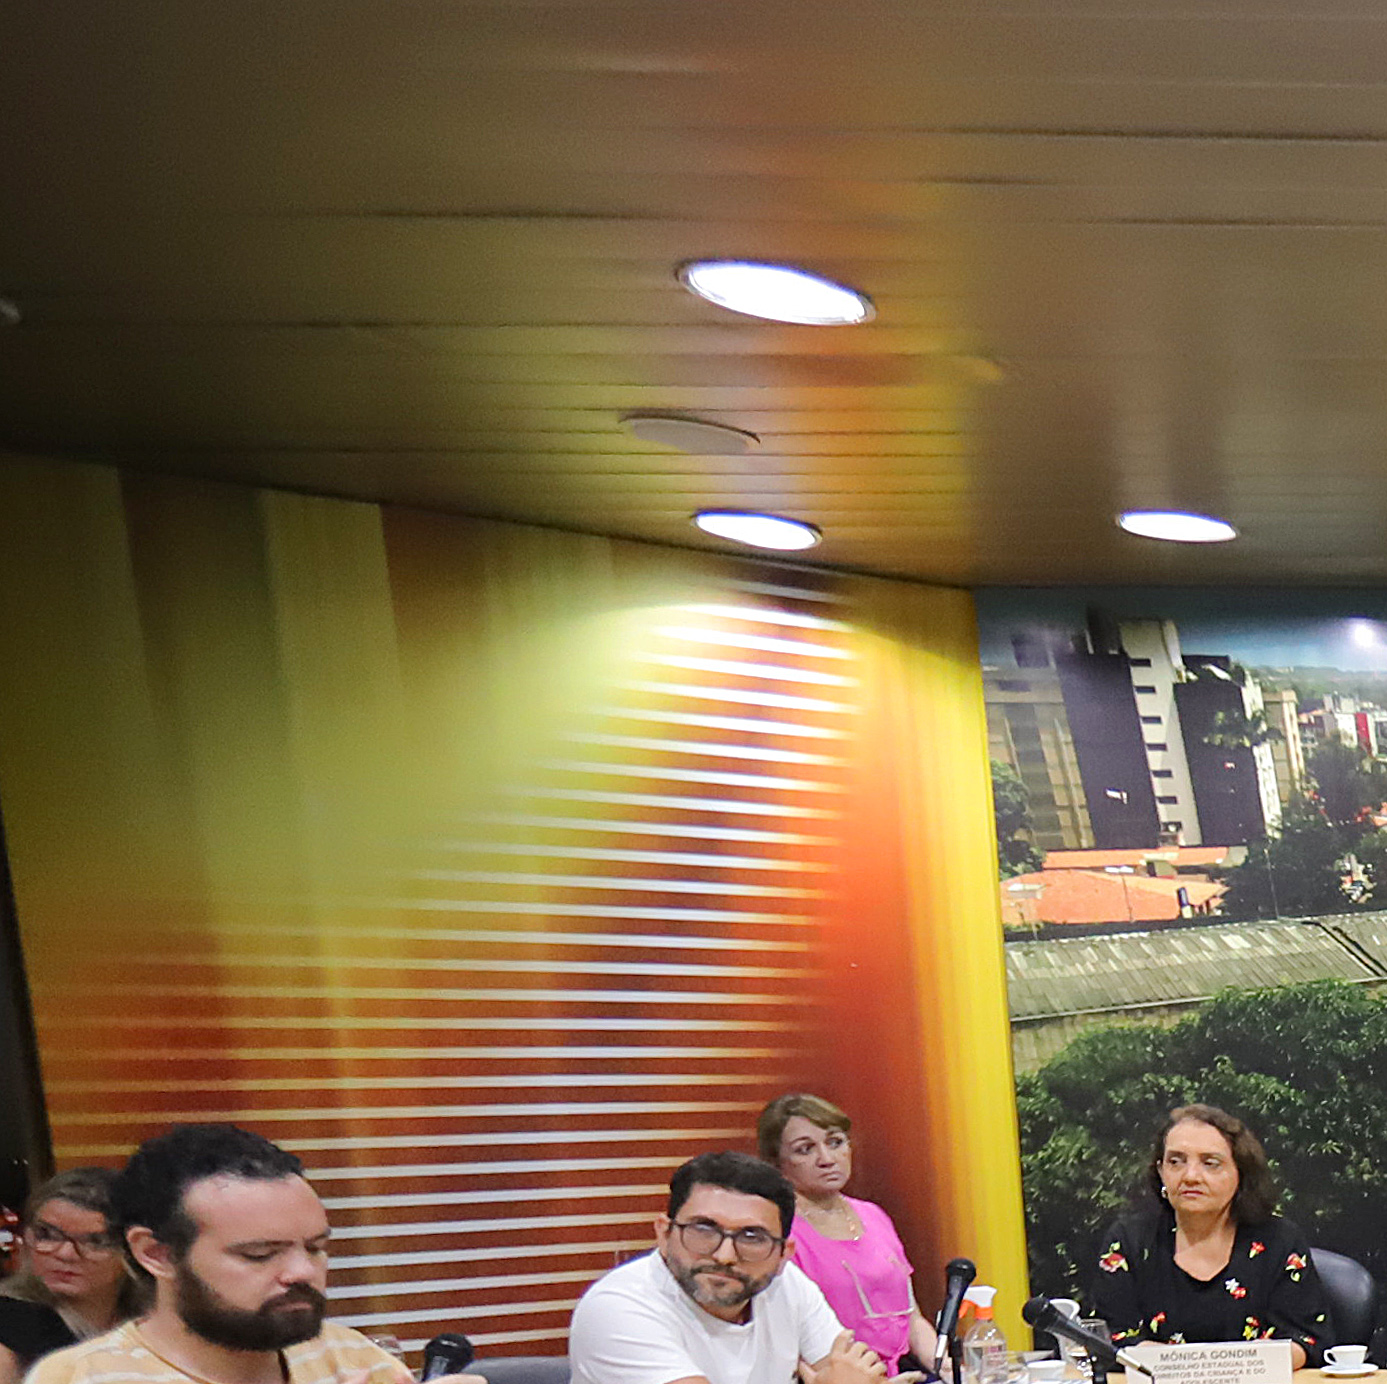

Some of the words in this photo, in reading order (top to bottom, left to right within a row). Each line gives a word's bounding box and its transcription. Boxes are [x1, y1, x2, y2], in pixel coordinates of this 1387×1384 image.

[1160, 1350, 1207, 1362] MÔNICA
[1211, 1348, 1257, 1359] GONDIM
[1153, 1362, 1200, 1372] CONSELHO
[1201, 1360, 1244, 1369] ESTADUAL
[1207, 1369, 1244, 1378] CRIANÇA
